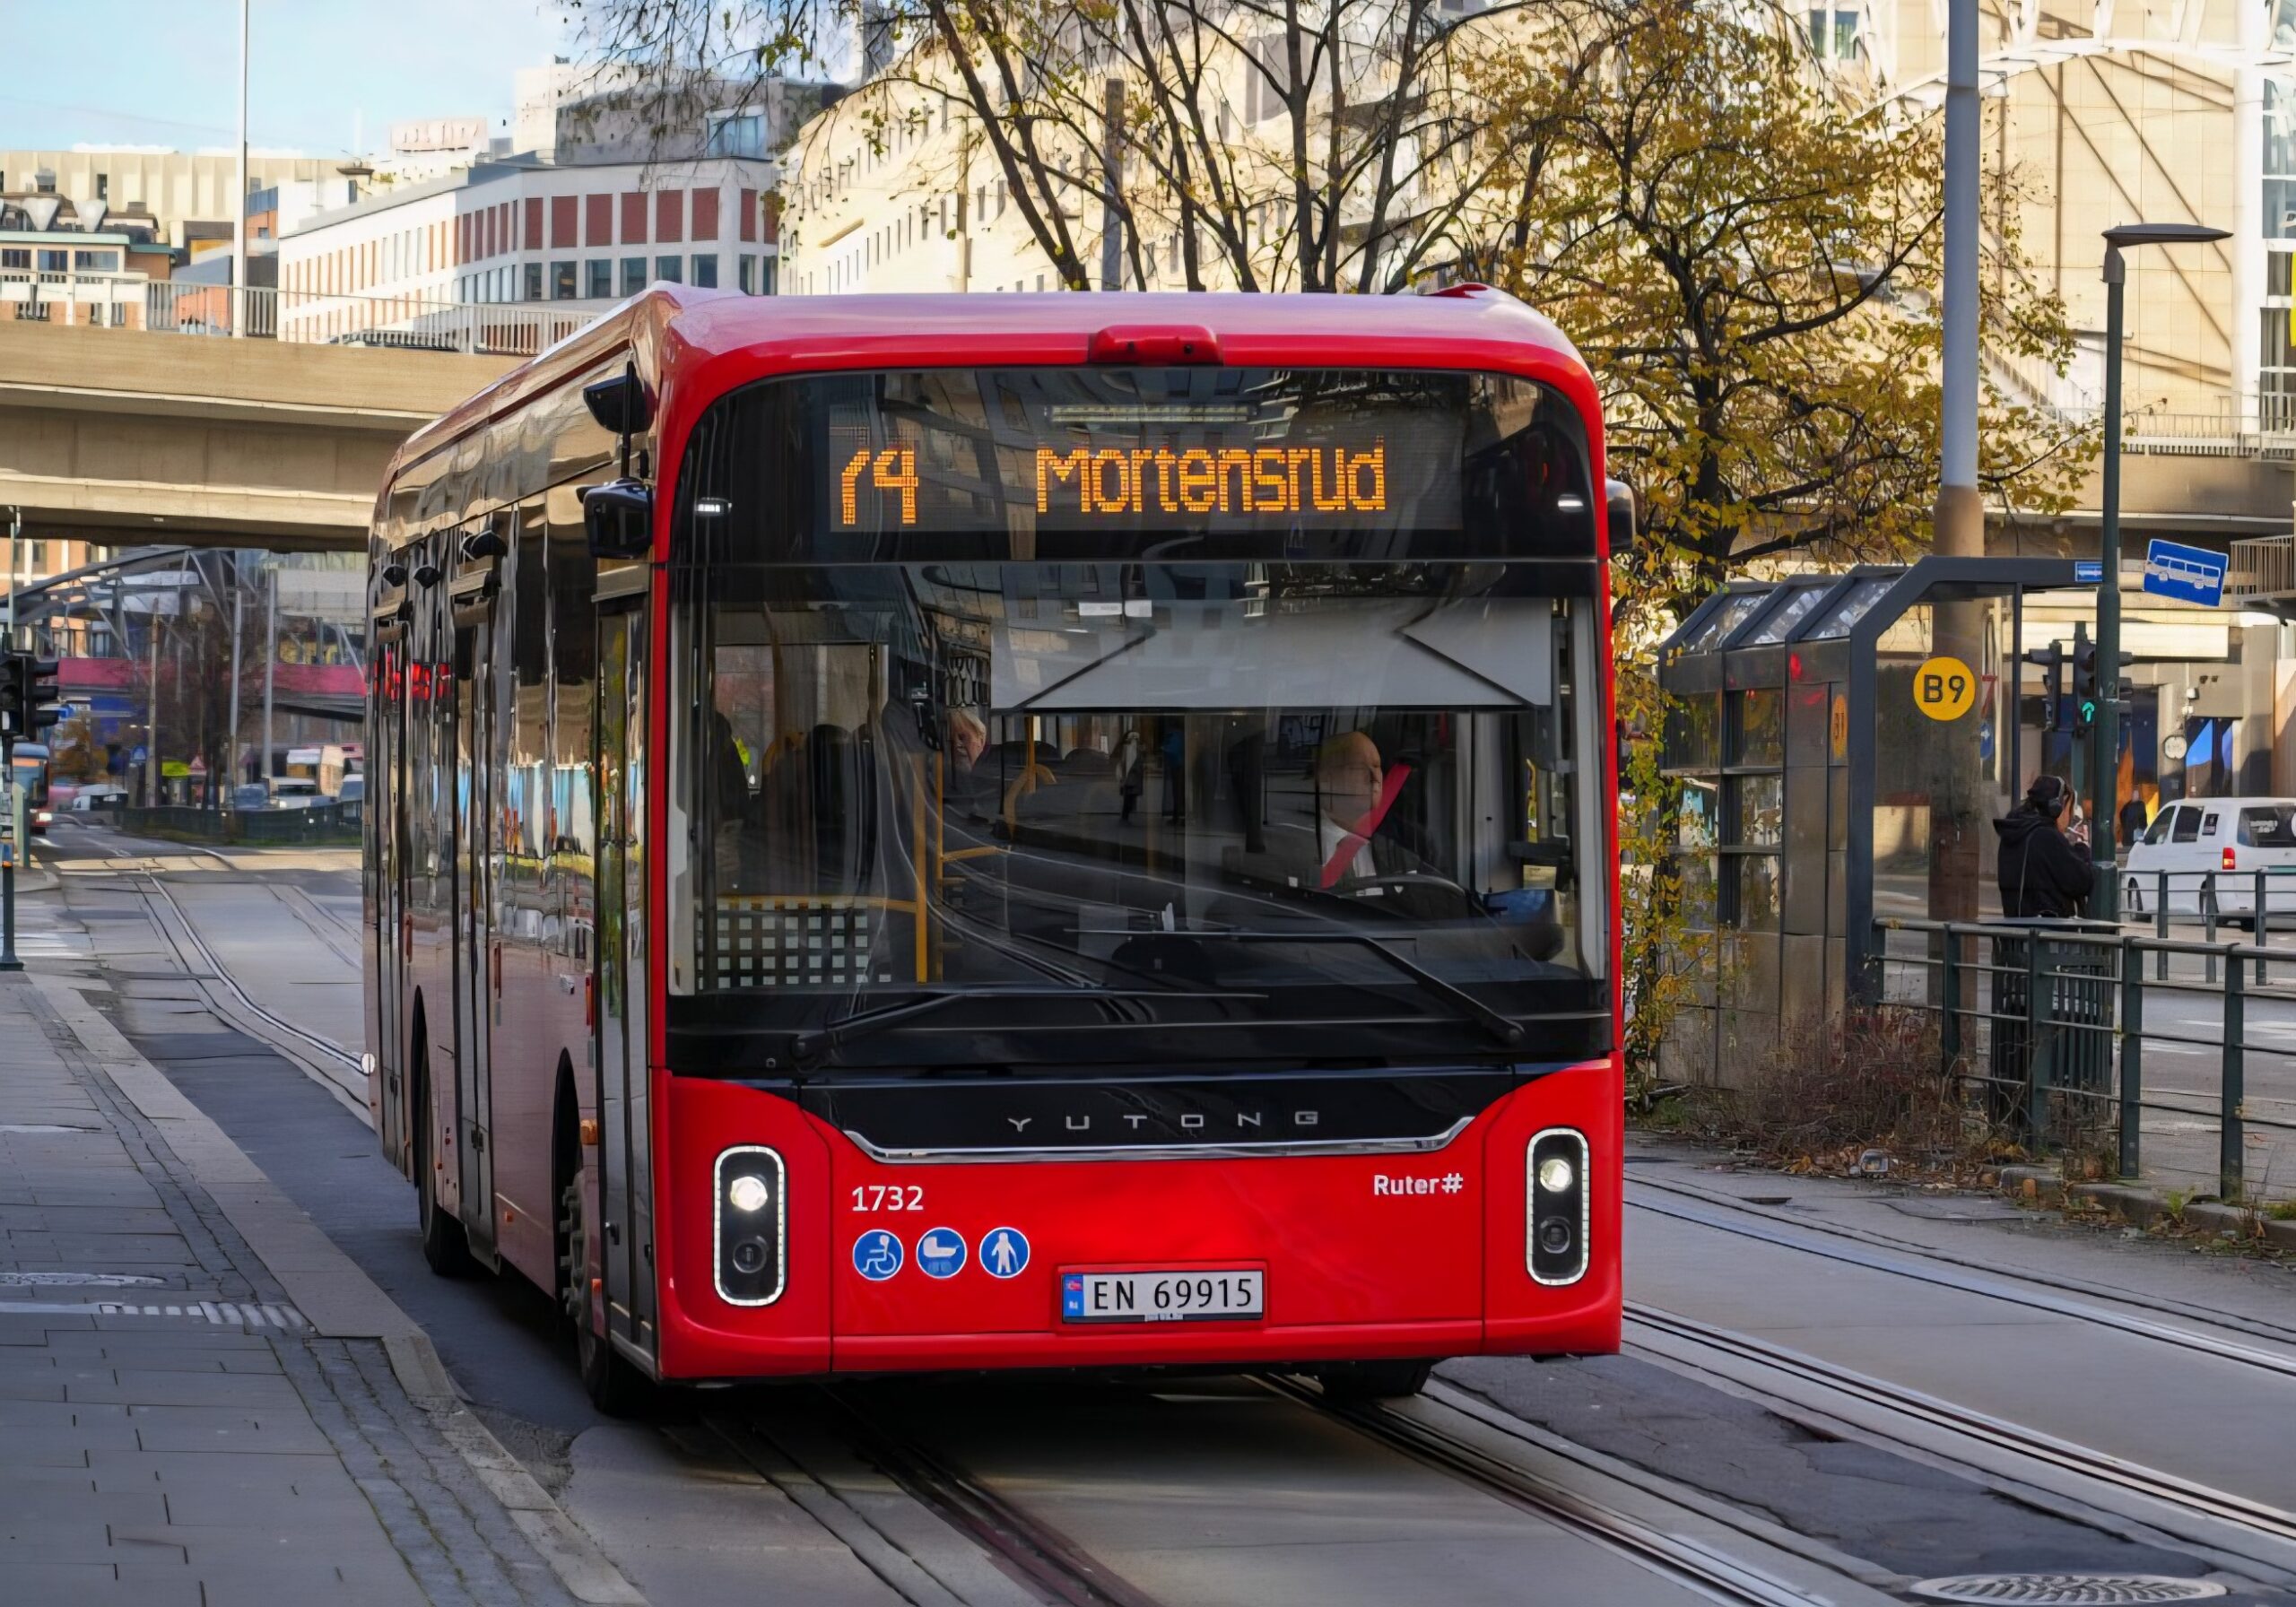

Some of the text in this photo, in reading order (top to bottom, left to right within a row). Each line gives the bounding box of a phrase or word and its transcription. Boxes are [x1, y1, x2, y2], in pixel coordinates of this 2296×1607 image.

[1036, 436, 1386, 513] Mortensrud
[1924, 674, 1965, 703] B9
[1007, 1111, 1318, 1132] YUTONG
[1373, 1172, 1464, 1195] Ruter#
[852, 1186, 924, 1212] 1732
[1094, 1279, 1252, 1310] EN 69915
